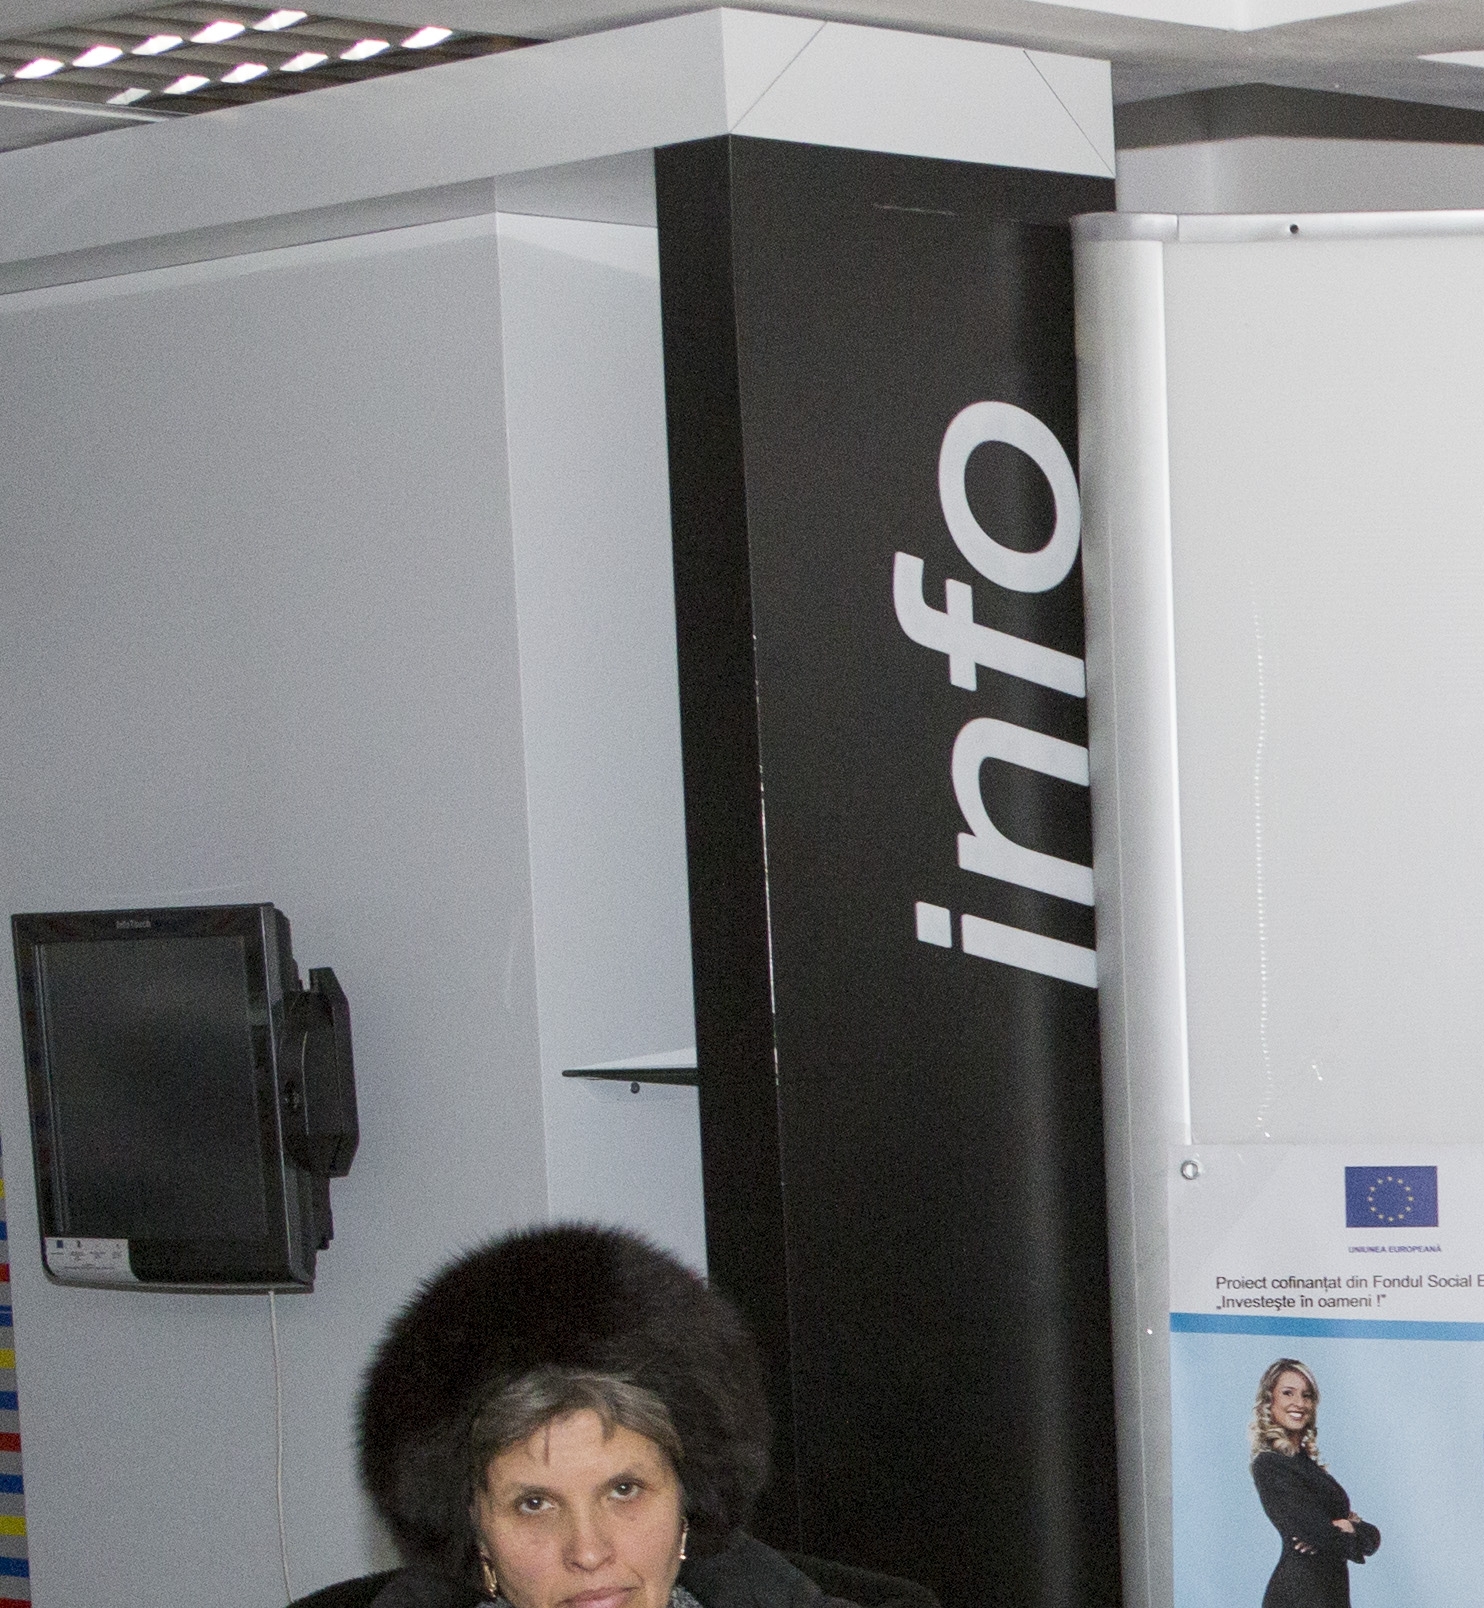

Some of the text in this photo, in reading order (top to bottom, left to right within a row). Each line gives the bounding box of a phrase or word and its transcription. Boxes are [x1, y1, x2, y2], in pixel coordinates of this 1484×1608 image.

[893, 400, 1098, 989] info
[1215, 1275, 1267, 1290] Proiect
[1346, 1275, 1368, 1289] din
[1373, 1275, 1423, 1288] Fondul
[1427, 1274, 1472, 1288] Social
